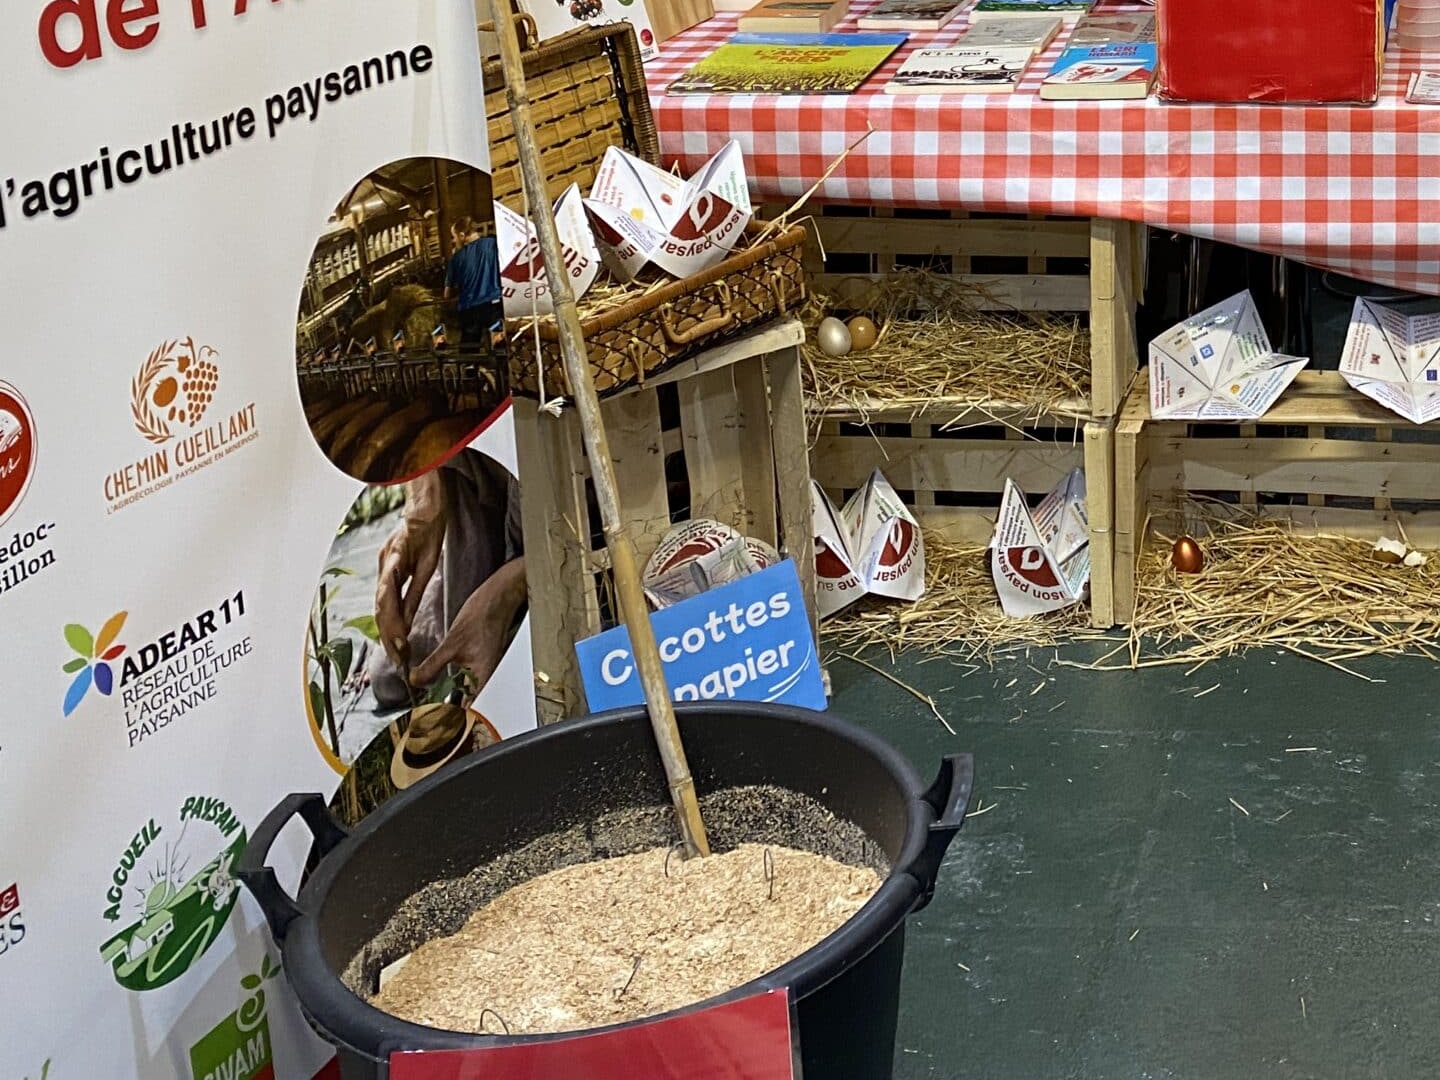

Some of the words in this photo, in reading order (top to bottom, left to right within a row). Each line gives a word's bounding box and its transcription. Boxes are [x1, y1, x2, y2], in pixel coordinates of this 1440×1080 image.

[265, 43, 434, 138] paysanne
[104, 449, 169, 502] CHEMIN
[174, 402, 256, 467] CUEILLANT
[174, 456, 213, 481] PAYSANNE
[214, 450, 224, 462] EN
[0, 549, 57, 594] illon
[119, 609, 217, 688] ADEAR
[219, 590, 247, 626] 11
[122, 657, 188, 708] RÉSEAU
[193, 640, 216, 666] DE
[124, 636, 253, 728] L'AGRICULTURE
[601, 591, 792, 686] Ccottes
[673, 639, 796, 702] papier
[128, 680, 218, 748] PAYSANNE
[103, 818, 162, 924] ACCUEIL
[180, 796, 241, 838] PAYSAN
